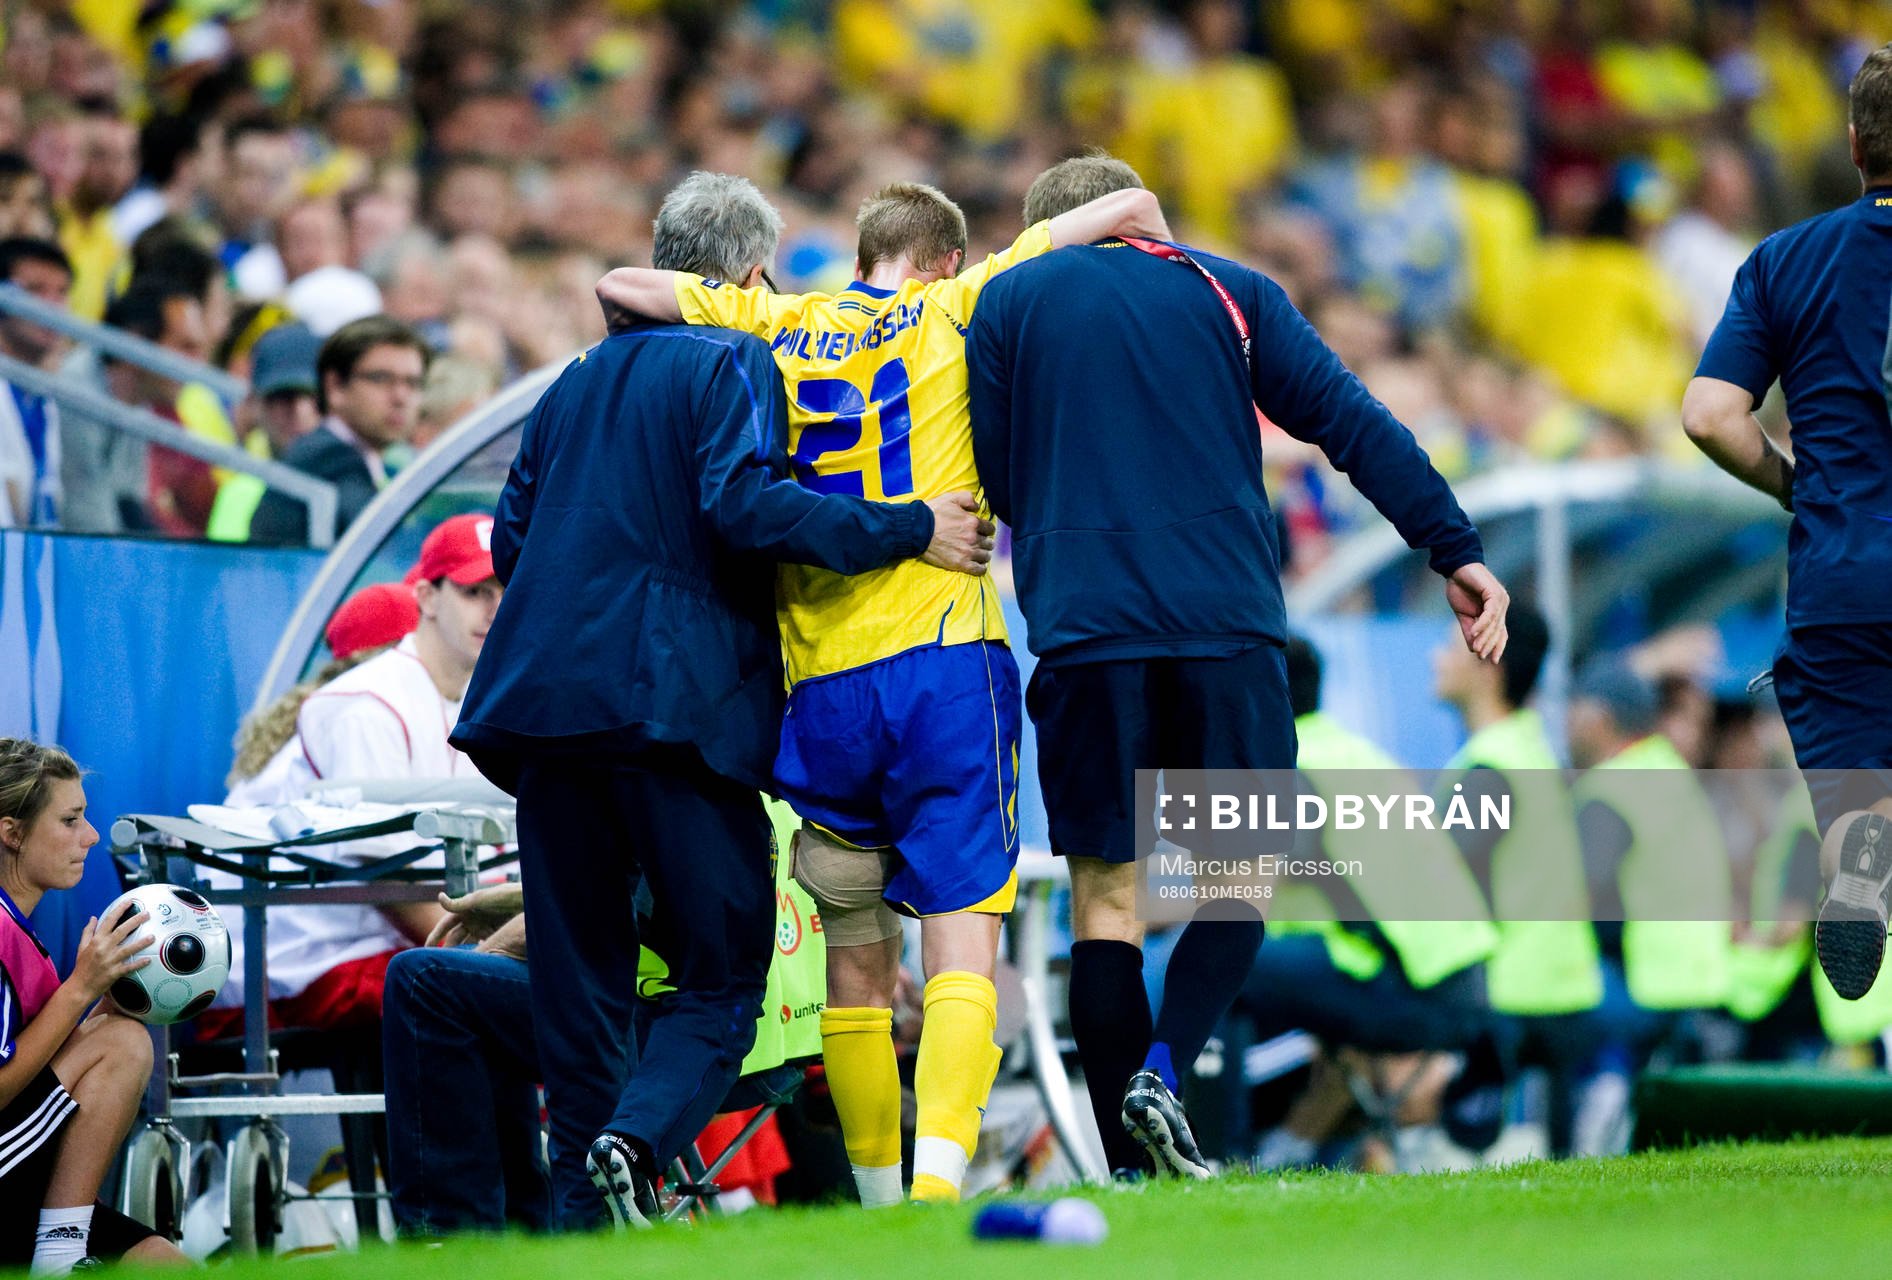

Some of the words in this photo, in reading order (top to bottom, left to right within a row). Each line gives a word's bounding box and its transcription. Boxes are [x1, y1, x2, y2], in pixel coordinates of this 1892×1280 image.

[790, 357, 914, 499] 21
[794, 1002, 824, 1019] unite
[45, 1230, 84, 1240] adidas
